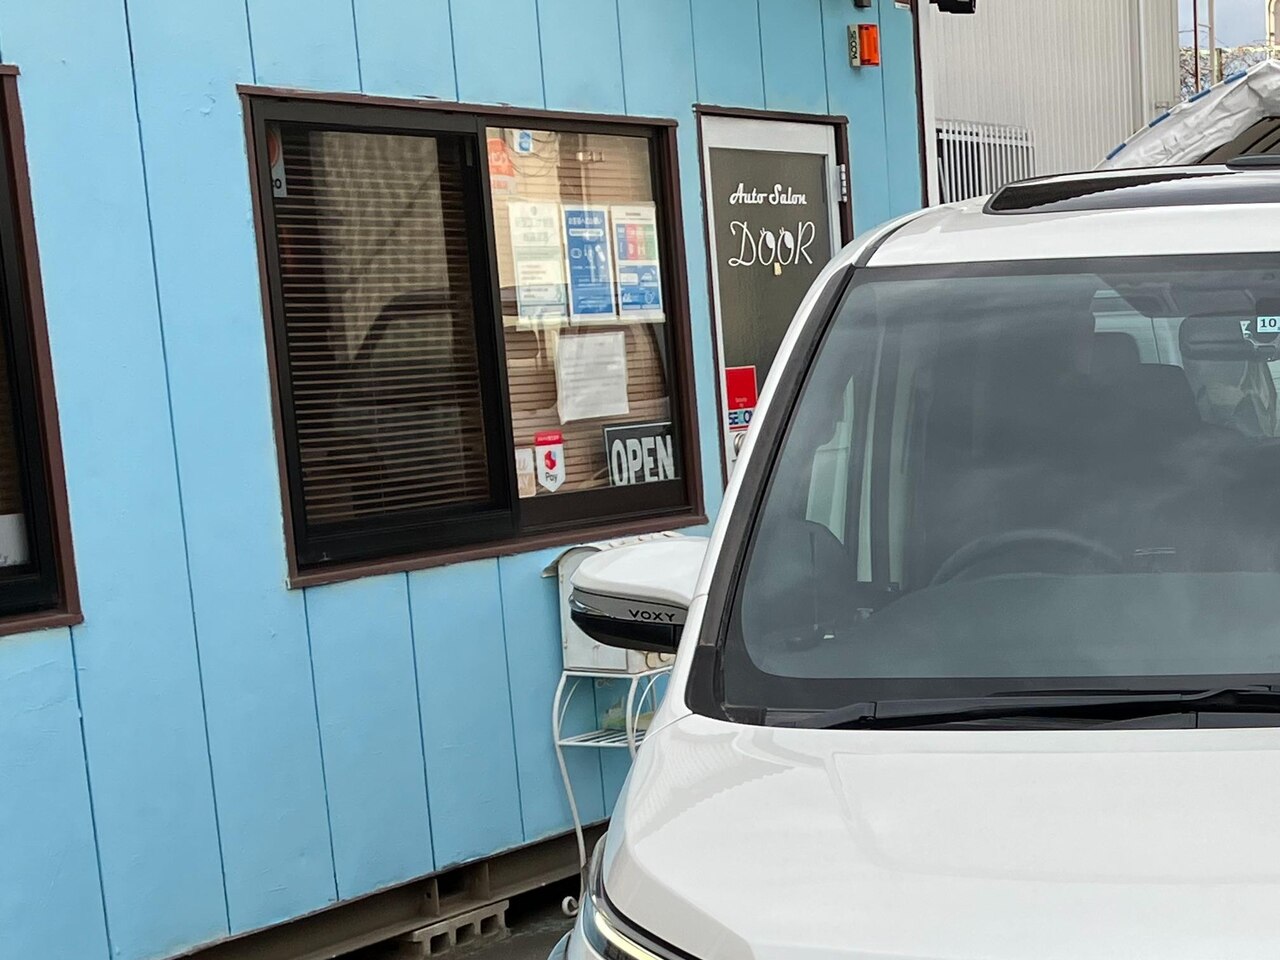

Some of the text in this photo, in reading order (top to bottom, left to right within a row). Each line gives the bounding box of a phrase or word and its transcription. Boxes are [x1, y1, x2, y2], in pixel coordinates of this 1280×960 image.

[729, 182, 808, 205] Auto Salon
[728, 221, 816, 266] DOOR
[1260, 318, 1277, 328] 10
[611, 434, 675, 487] OPEN
[545, 472, 558, 483] Pay
[628, 609, 676, 622] VOXY
